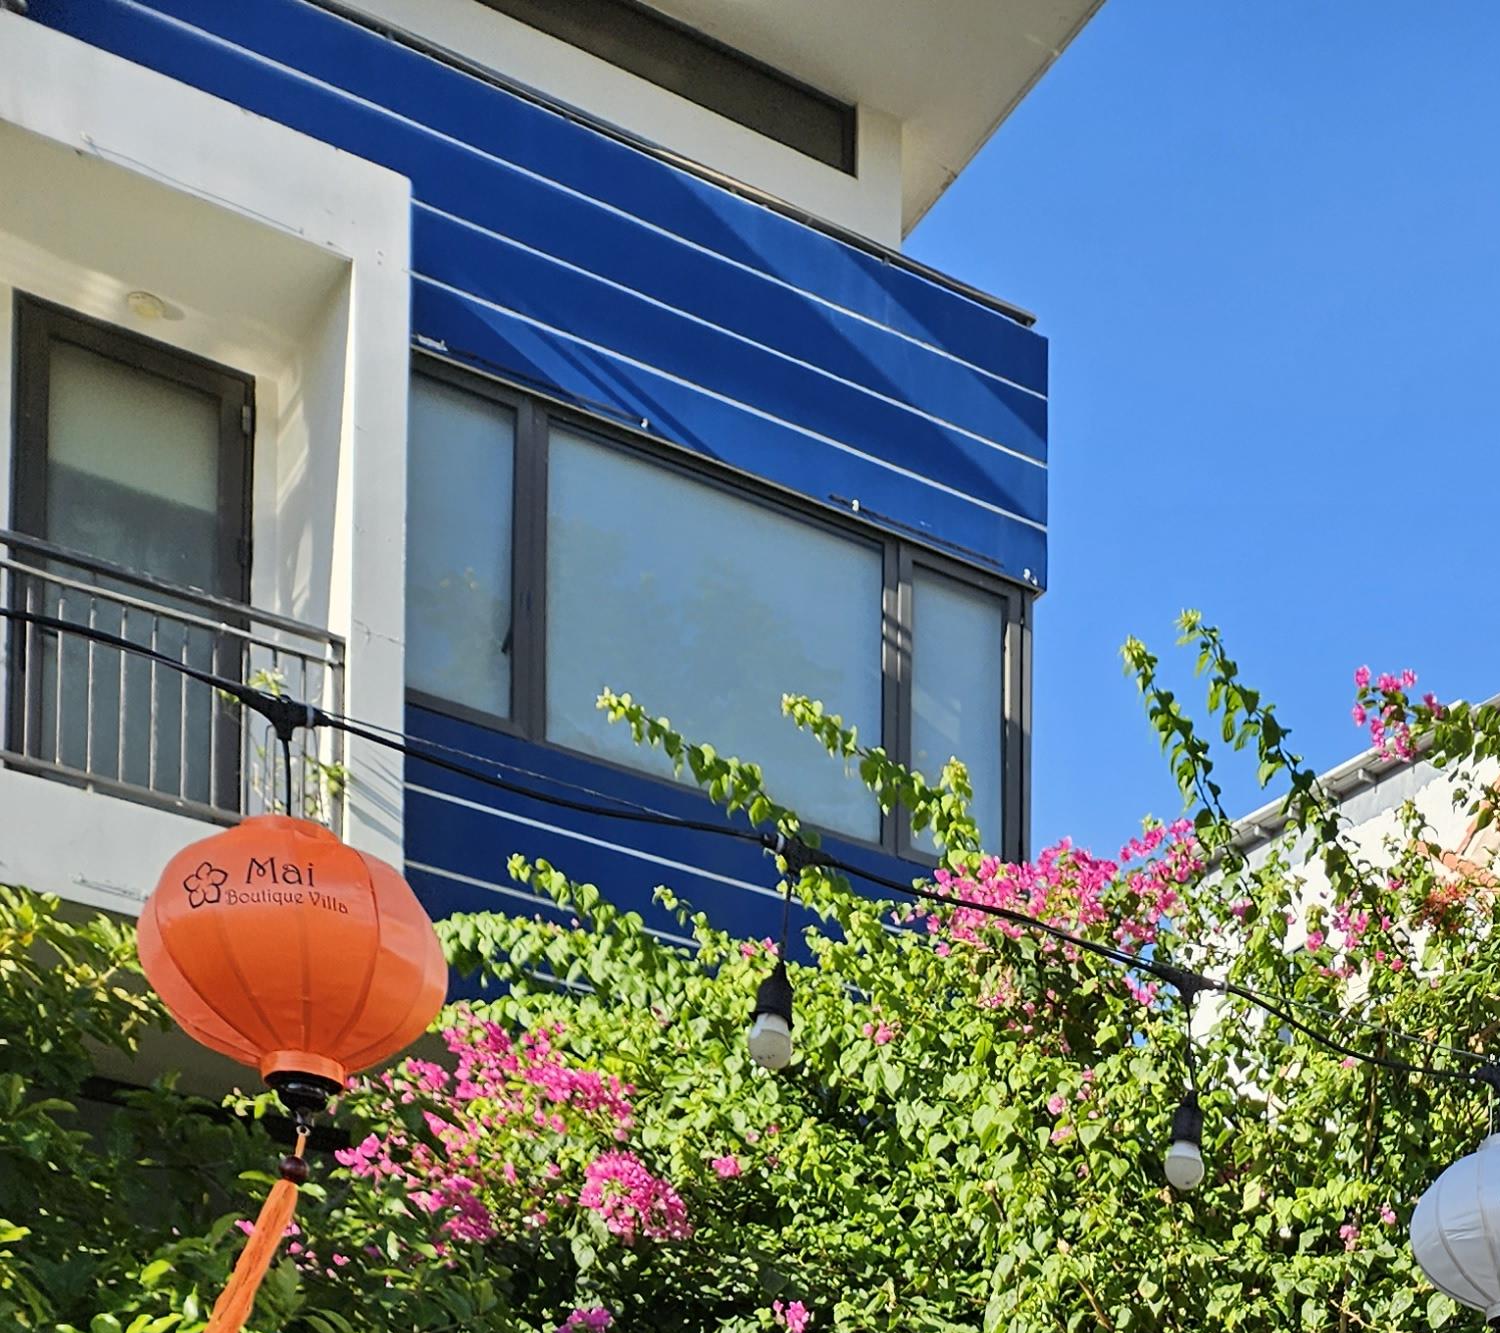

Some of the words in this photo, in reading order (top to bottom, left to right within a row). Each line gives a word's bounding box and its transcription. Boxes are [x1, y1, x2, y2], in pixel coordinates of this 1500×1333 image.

[246, 856, 315, 887] Mai
[225, 888, 304, 907] Boutique
[308, 891, 349, 915] Villa
